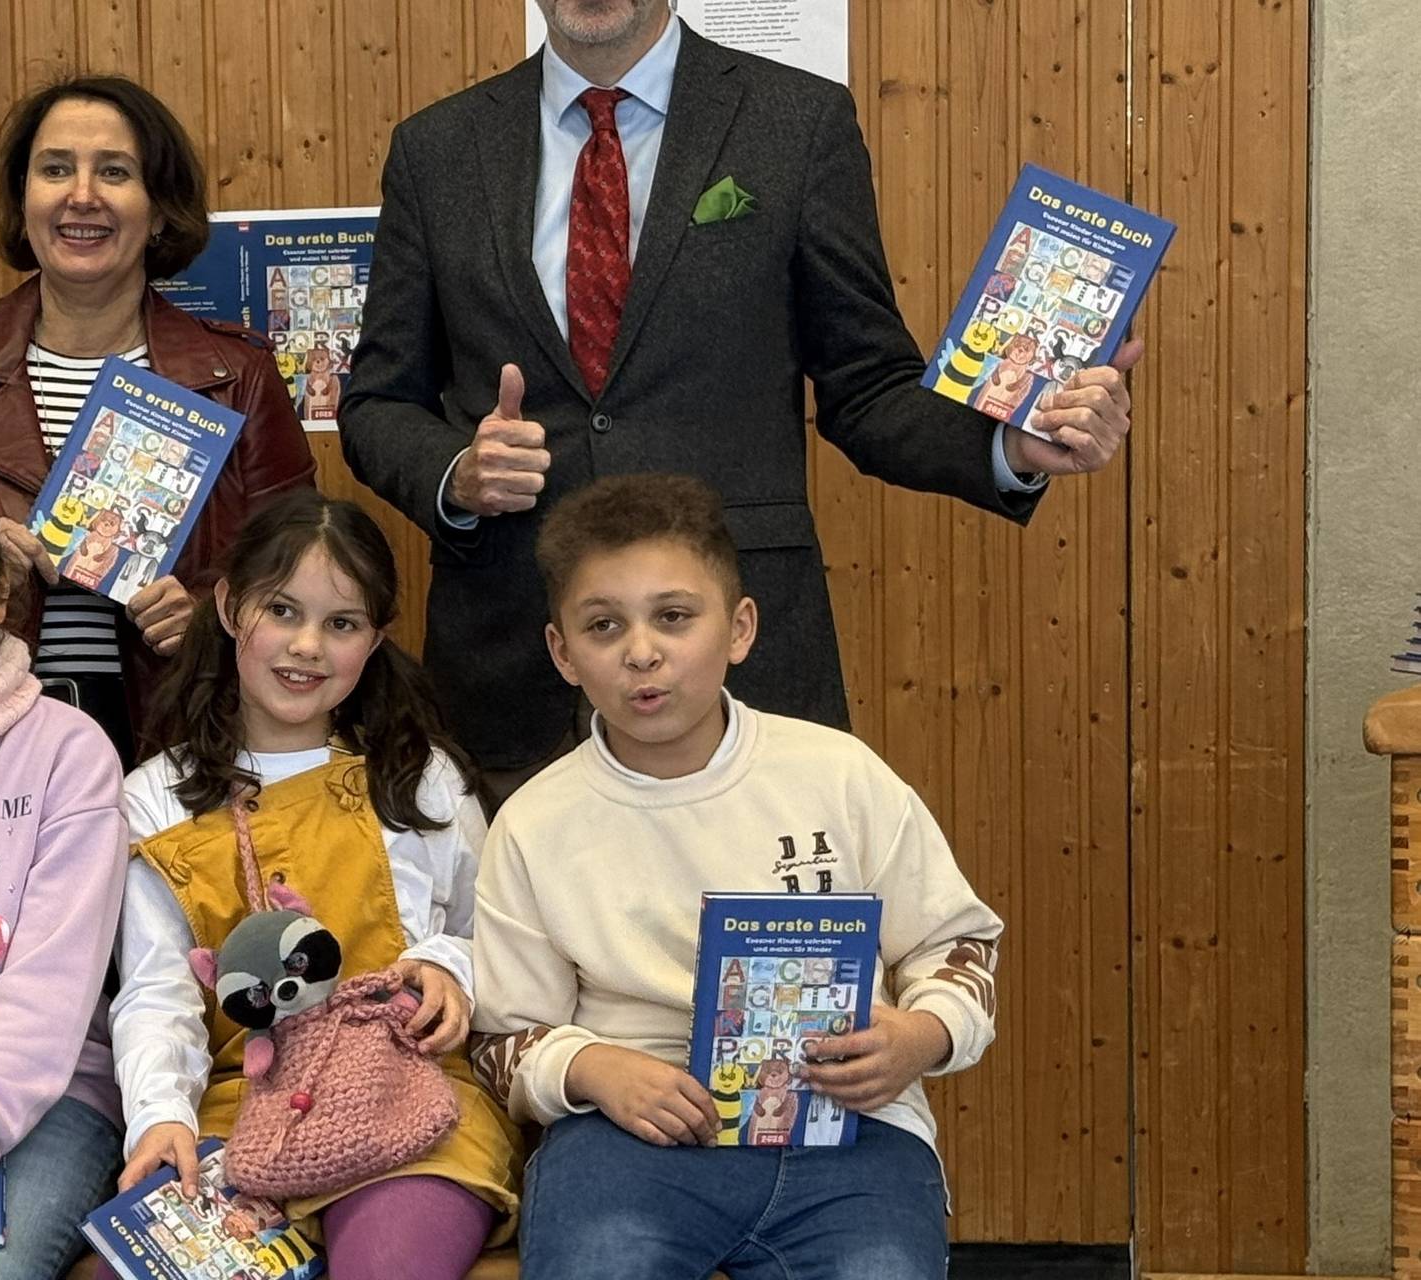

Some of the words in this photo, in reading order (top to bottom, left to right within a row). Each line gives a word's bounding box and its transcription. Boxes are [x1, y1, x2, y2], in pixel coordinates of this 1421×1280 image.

[1028, 186, 1061, 209] Das
[1065, 204, 1107, 228] erste
[1110, 220, 1153, 248] Buch
[265, 235, 293, 246] Das
[297, 233, 334, 245] erste
[338, 232, 375, 243] Buch
[112, 375, 143, 397] Das
[146, 393, 184, 417] erste
[187, 410, 226, 437] Buch
[1, 794, 33, 820] ME
[778, 836, 796, 860] D
[812, 831, 832, 855] A
[724, 918, 760, 932] Das
[766, 918, 814, 932] erste
[819, 918, 866, 933] Buch
